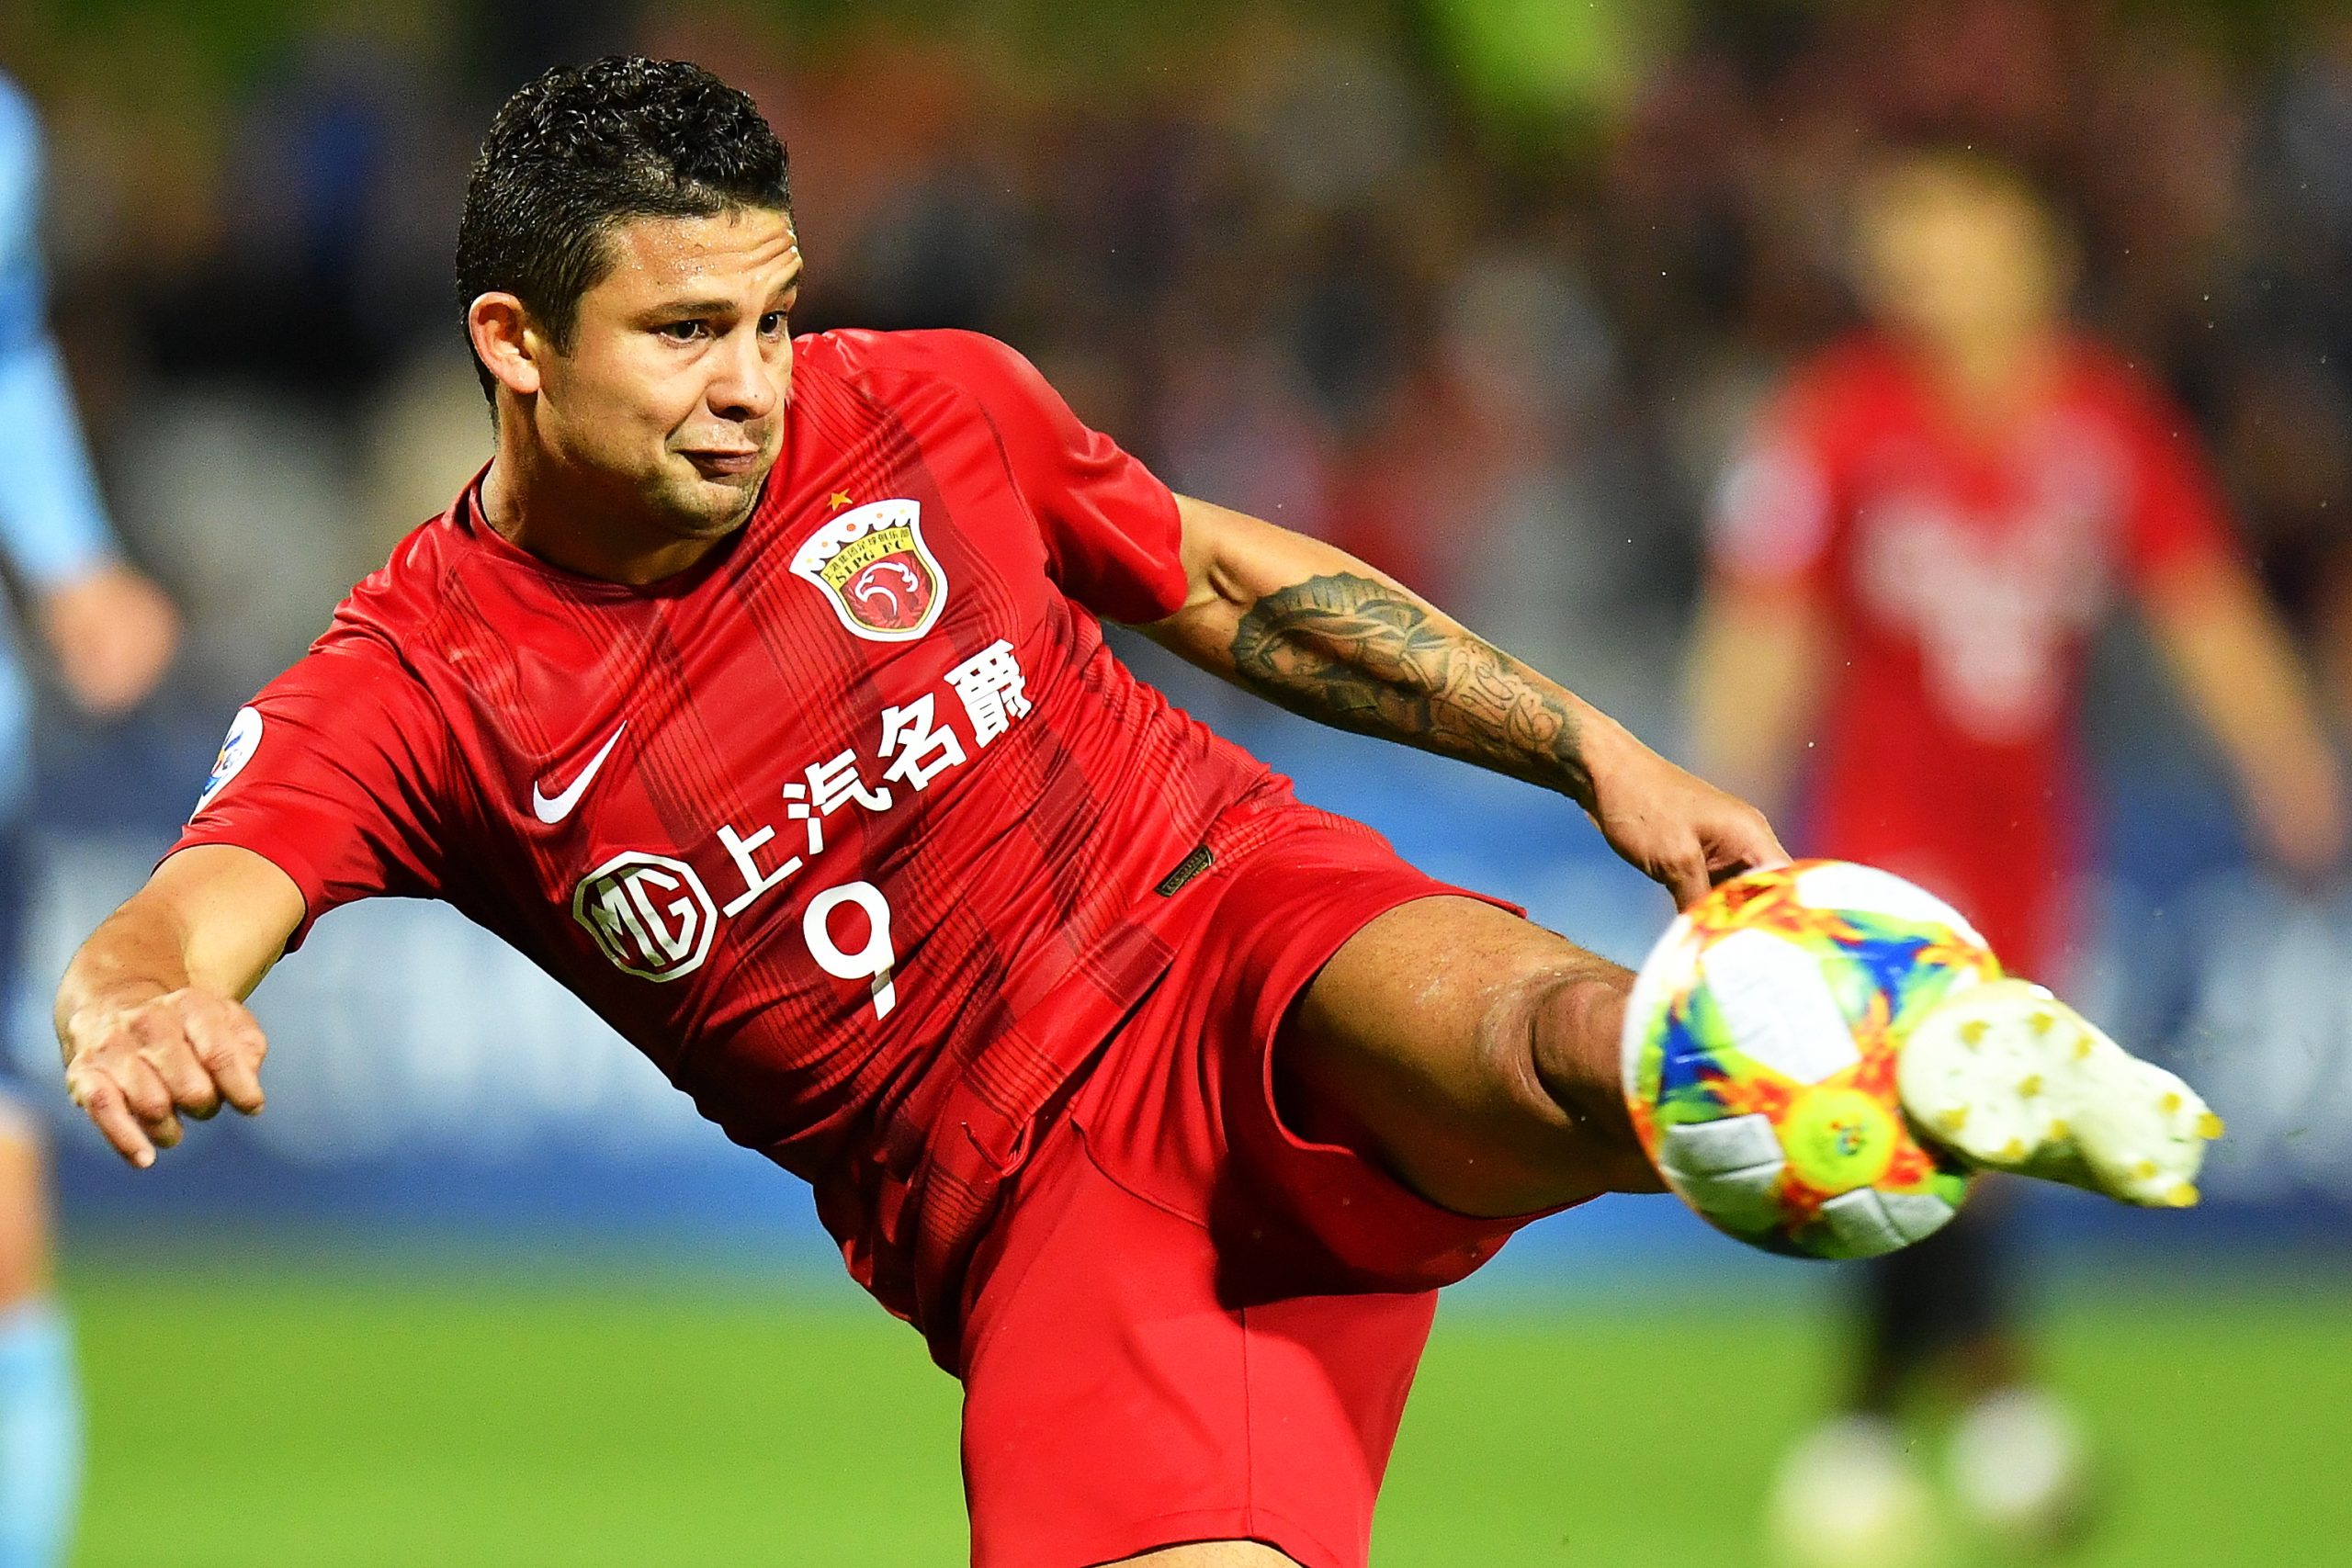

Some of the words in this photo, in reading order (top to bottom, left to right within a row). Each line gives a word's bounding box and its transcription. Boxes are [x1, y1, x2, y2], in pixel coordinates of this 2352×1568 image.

[835, 549, 876, 583] SIPG
[883, 538, 906, 554] FC
[716, 638, 1035, 919] 上汽名爵
[590, 866, 699, 968] MG
[802, 880, 897, 1021] 9
